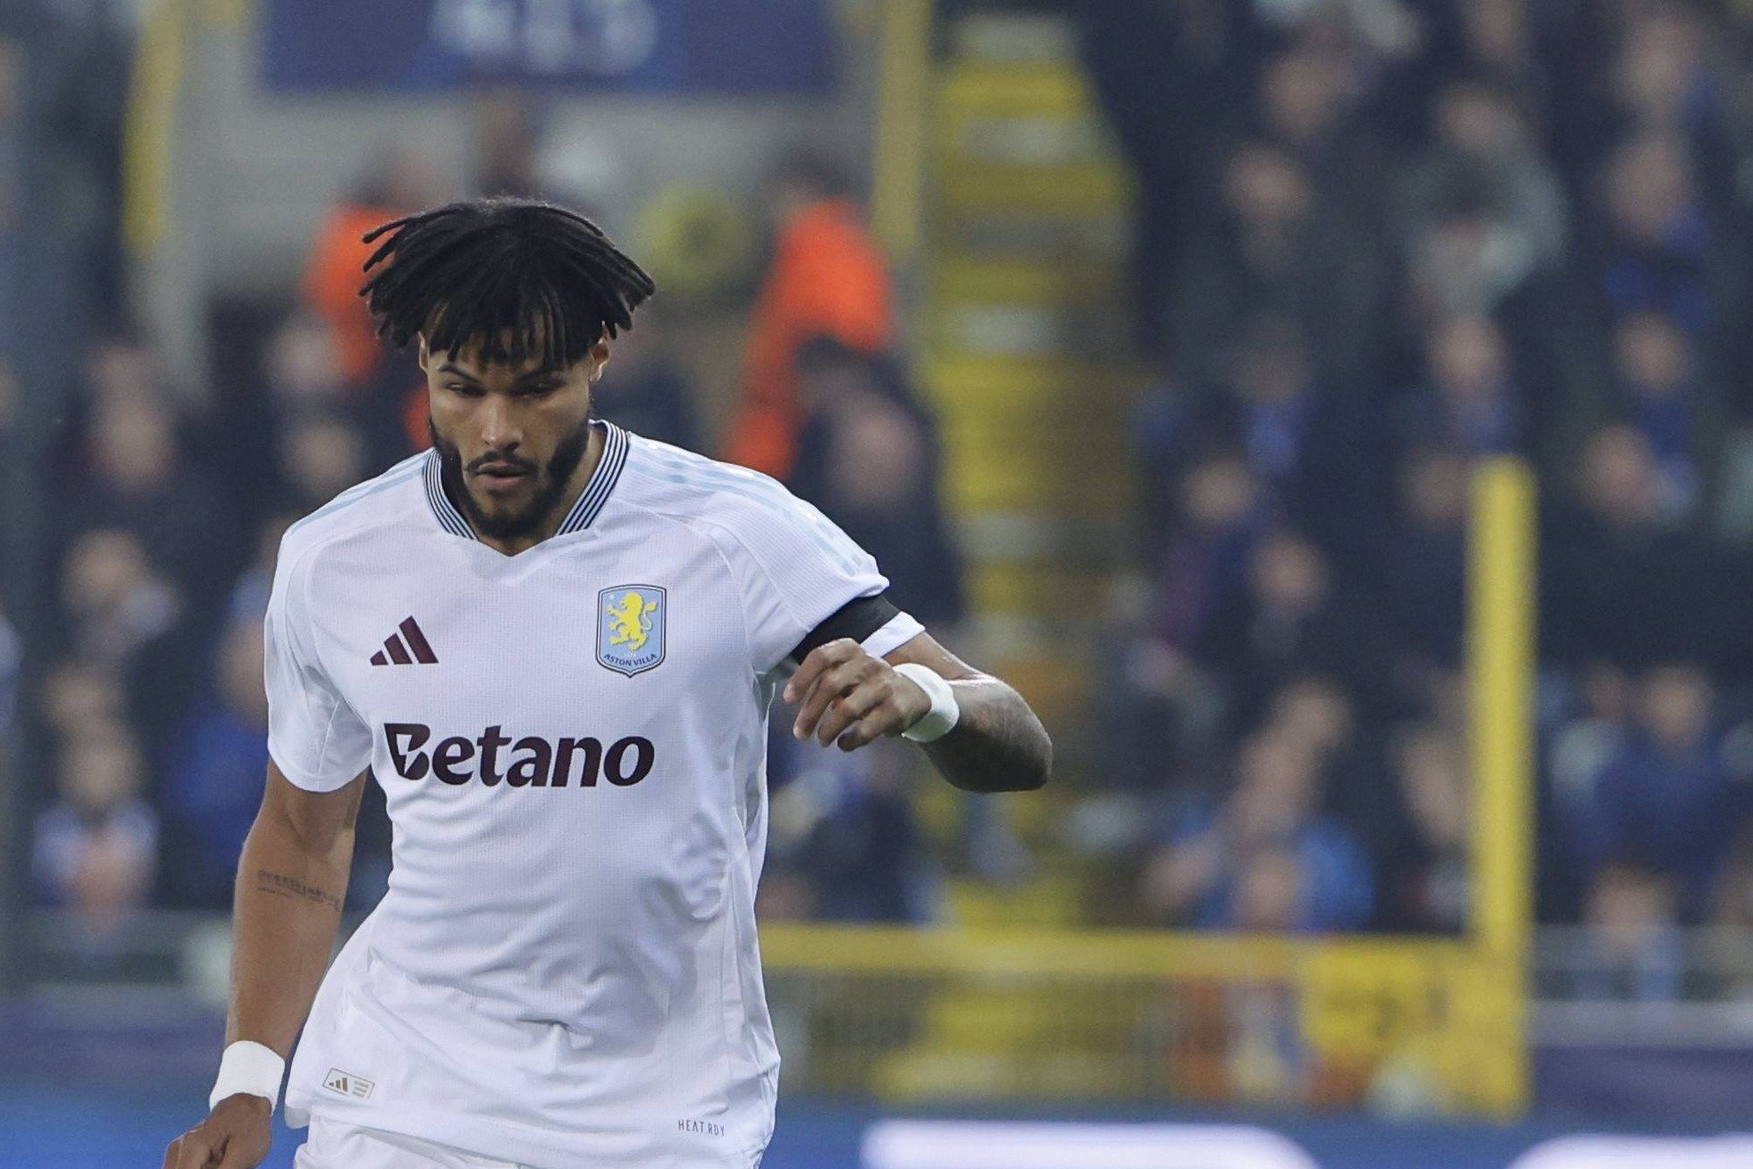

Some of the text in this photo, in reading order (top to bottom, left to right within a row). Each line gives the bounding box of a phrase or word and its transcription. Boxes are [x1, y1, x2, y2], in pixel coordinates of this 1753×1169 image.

[604, 653, 632, 666] ASTON
[633, 653, 658, 666] VILLA
[384, 723, 655, 787] Betano
